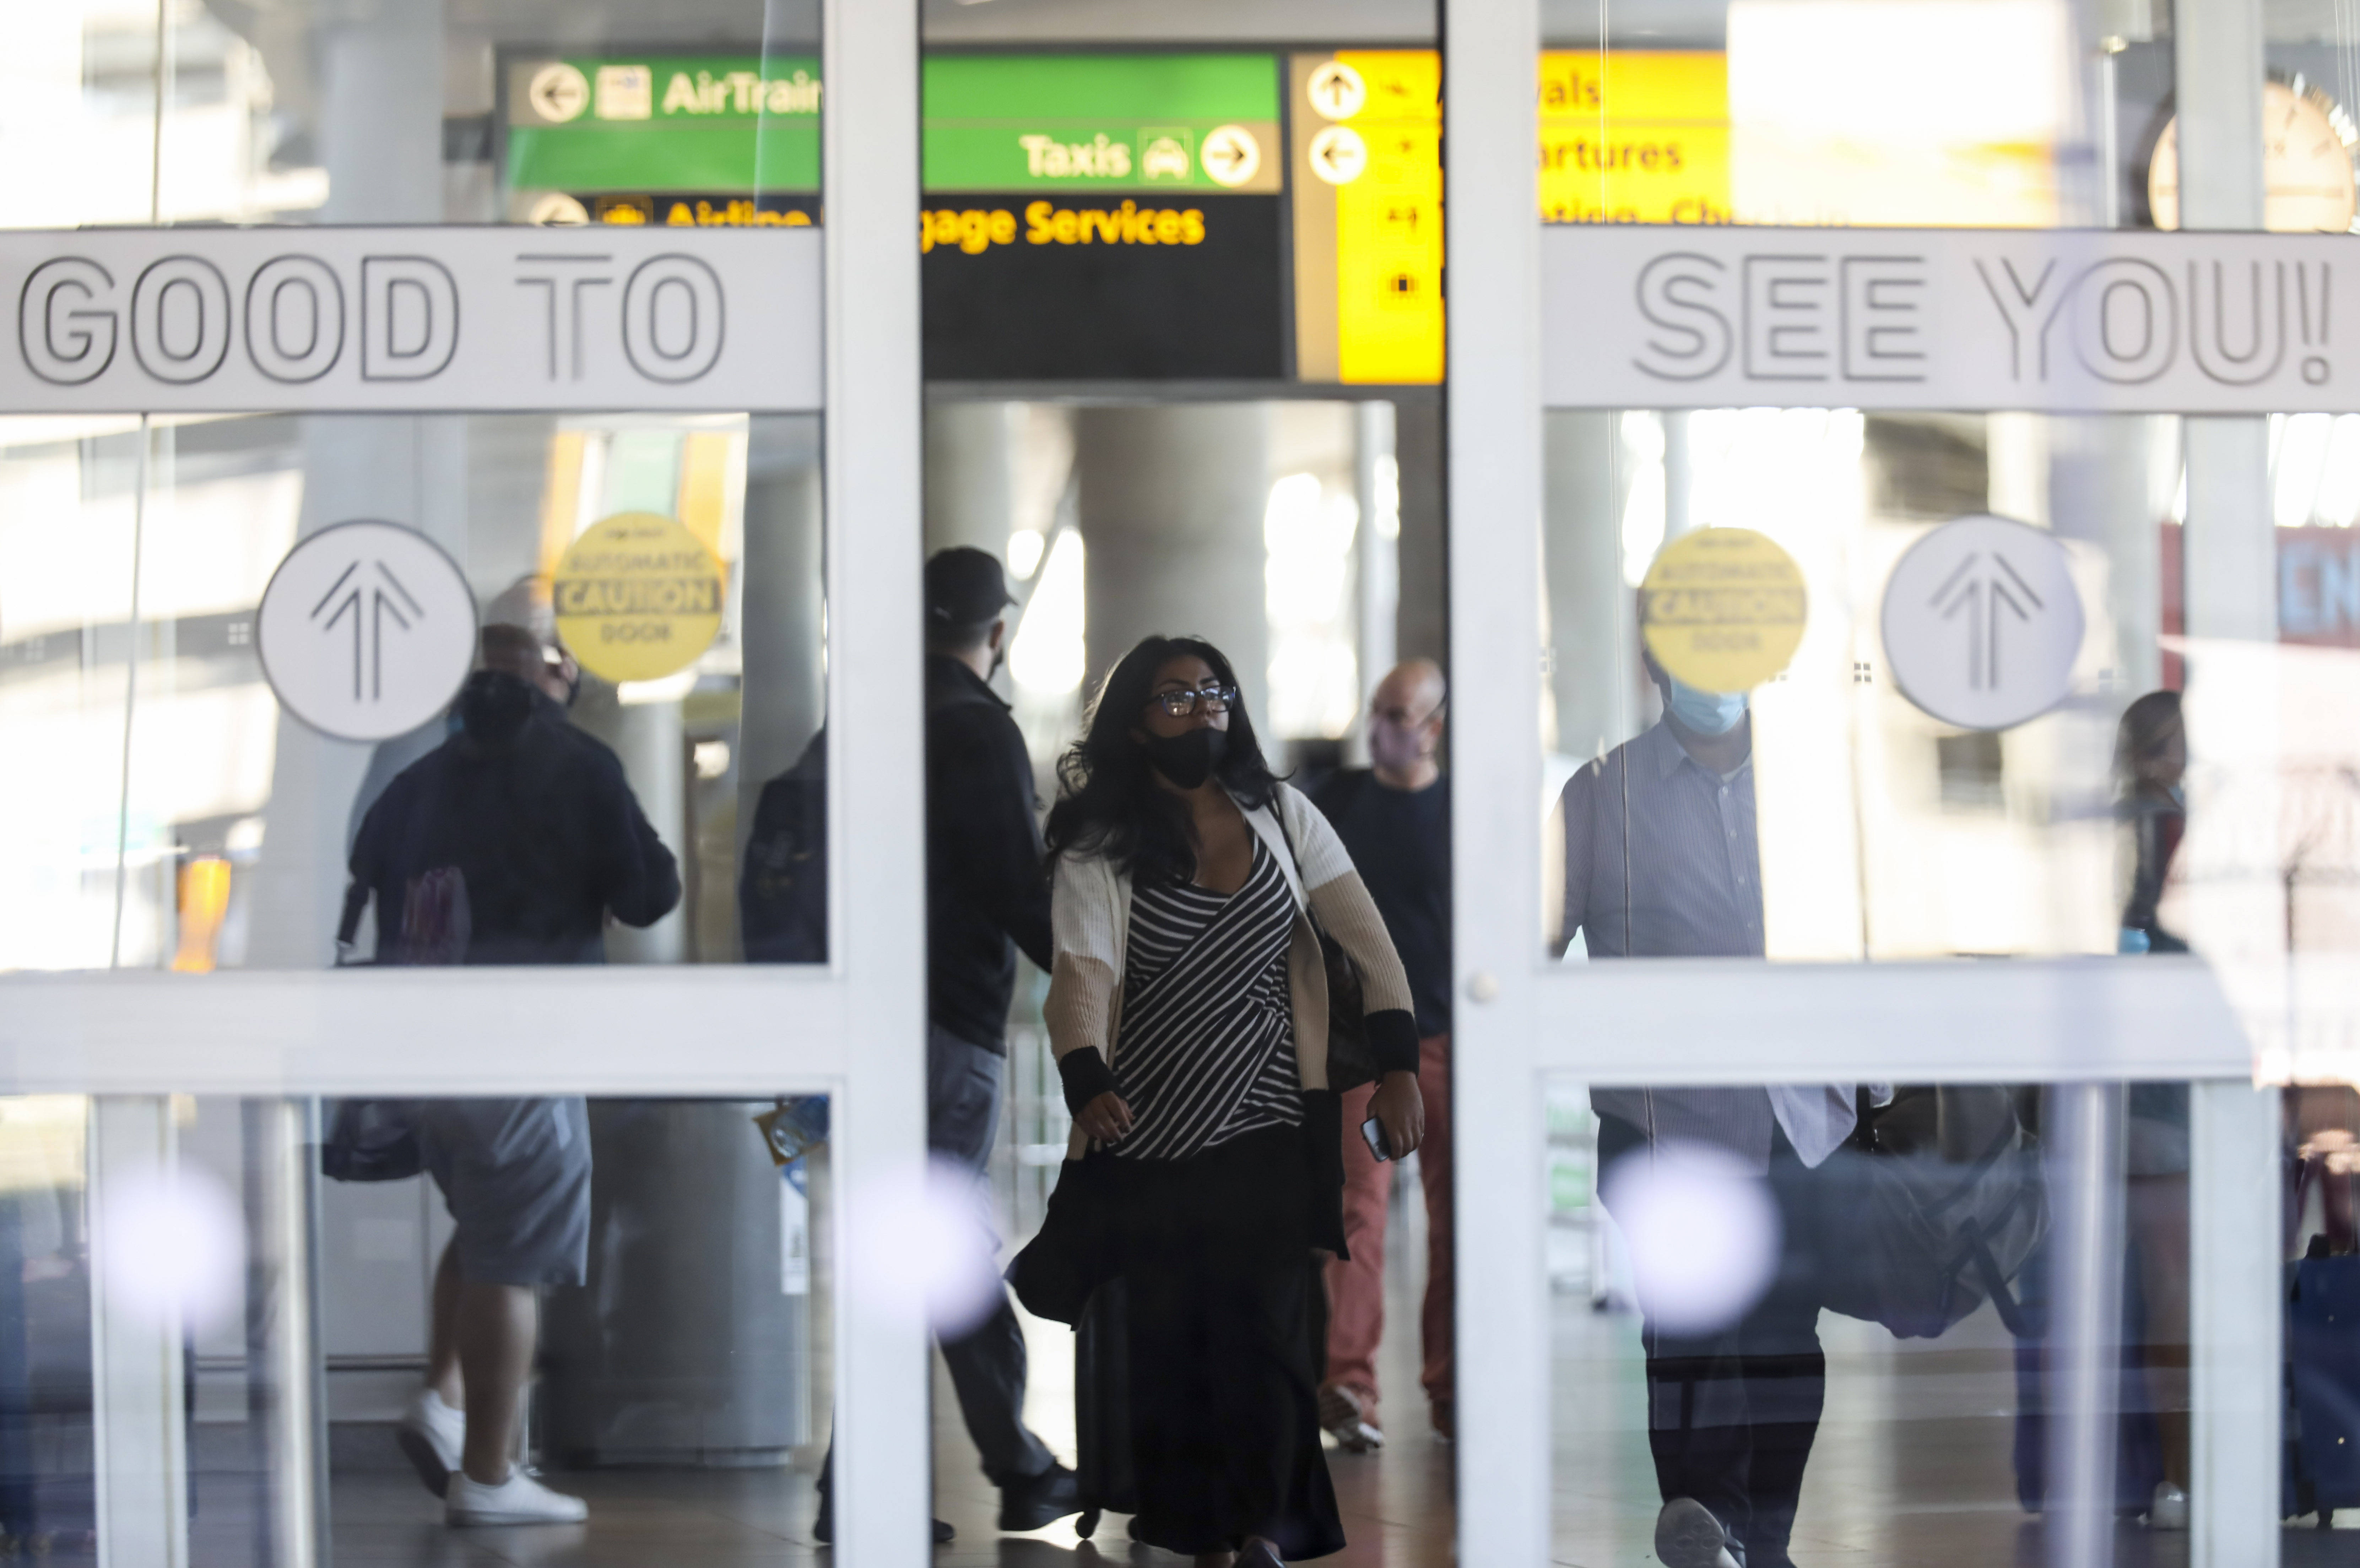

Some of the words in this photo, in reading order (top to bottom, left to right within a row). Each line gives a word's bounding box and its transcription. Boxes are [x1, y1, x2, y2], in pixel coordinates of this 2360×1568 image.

[1535, 72, 1600, 107] als
[1018, 134, 1132, 178] Taxis
[1025, 199, 1206, 245] Services
[17, 253, 461, 386] GOOD
[514, 252, 727, 385] TO
[1633, 251, 1926, 384] SEE
[562, 580, 711, 614] CAUTION
